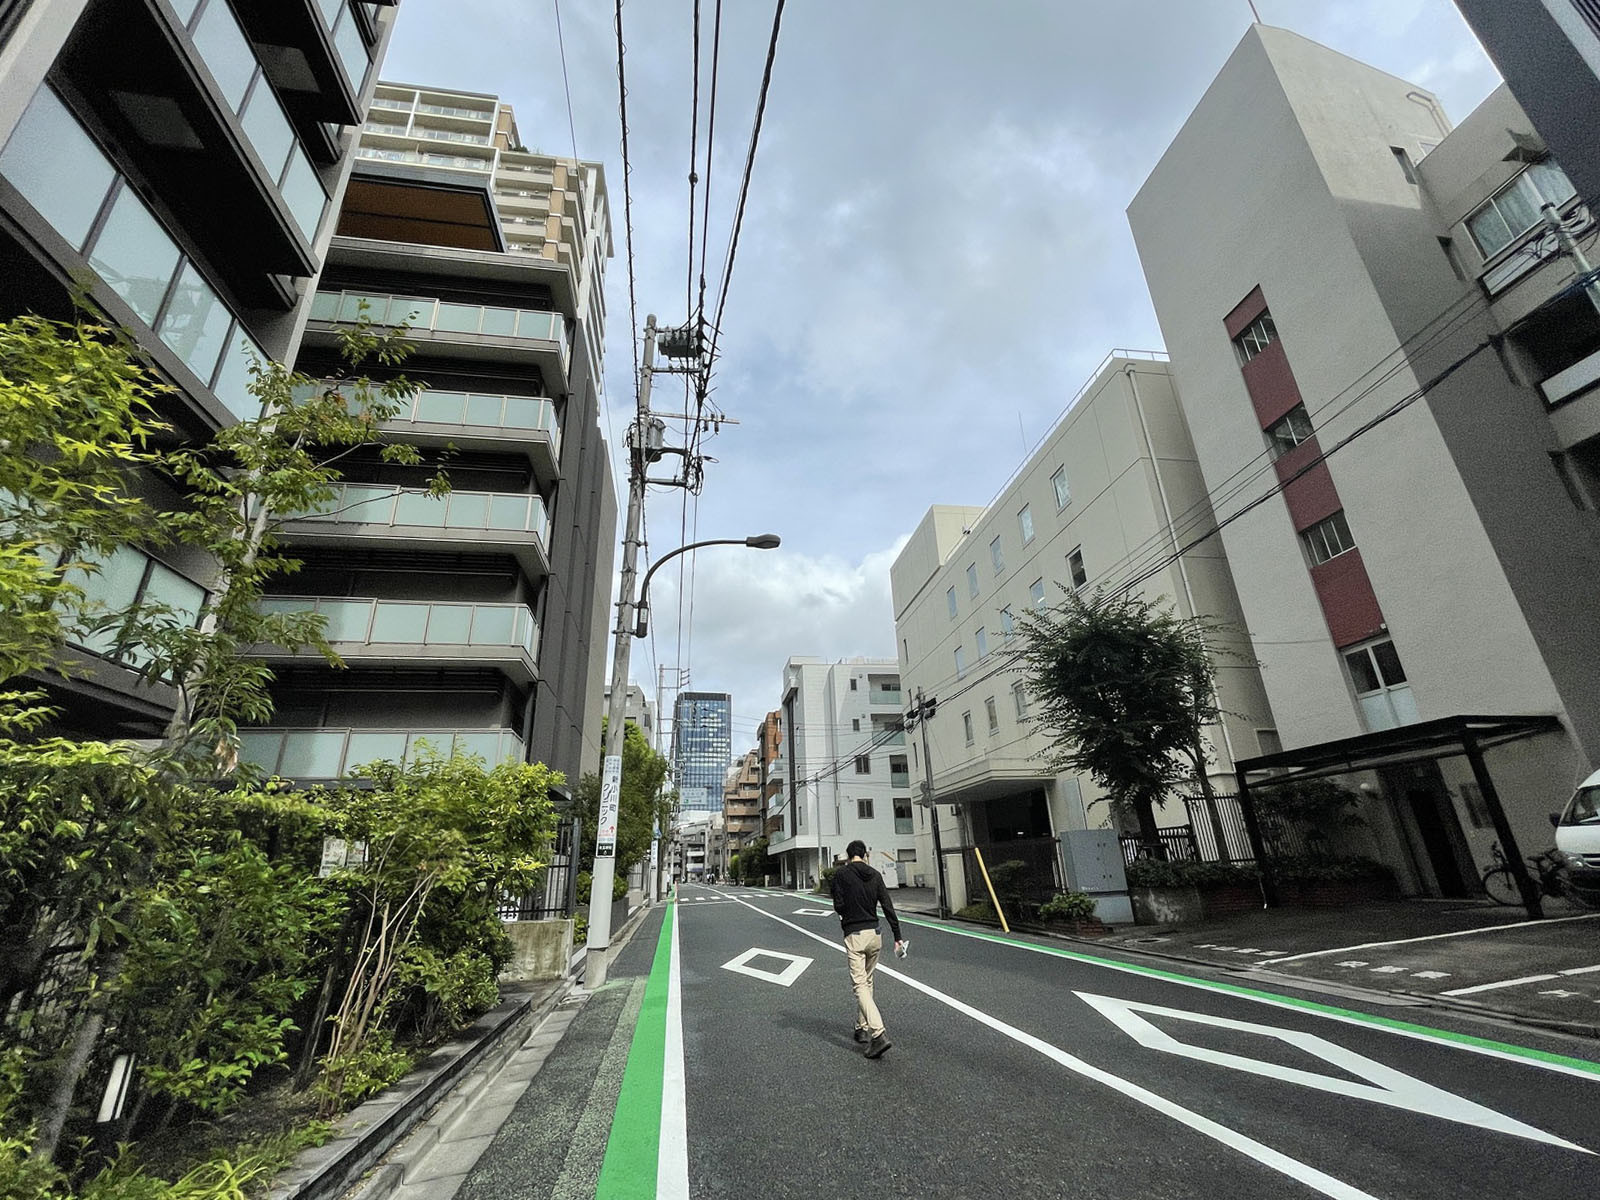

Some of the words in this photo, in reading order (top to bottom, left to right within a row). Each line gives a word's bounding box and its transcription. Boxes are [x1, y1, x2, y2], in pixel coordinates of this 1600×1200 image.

[600, 783, 611, 825] クリニック
